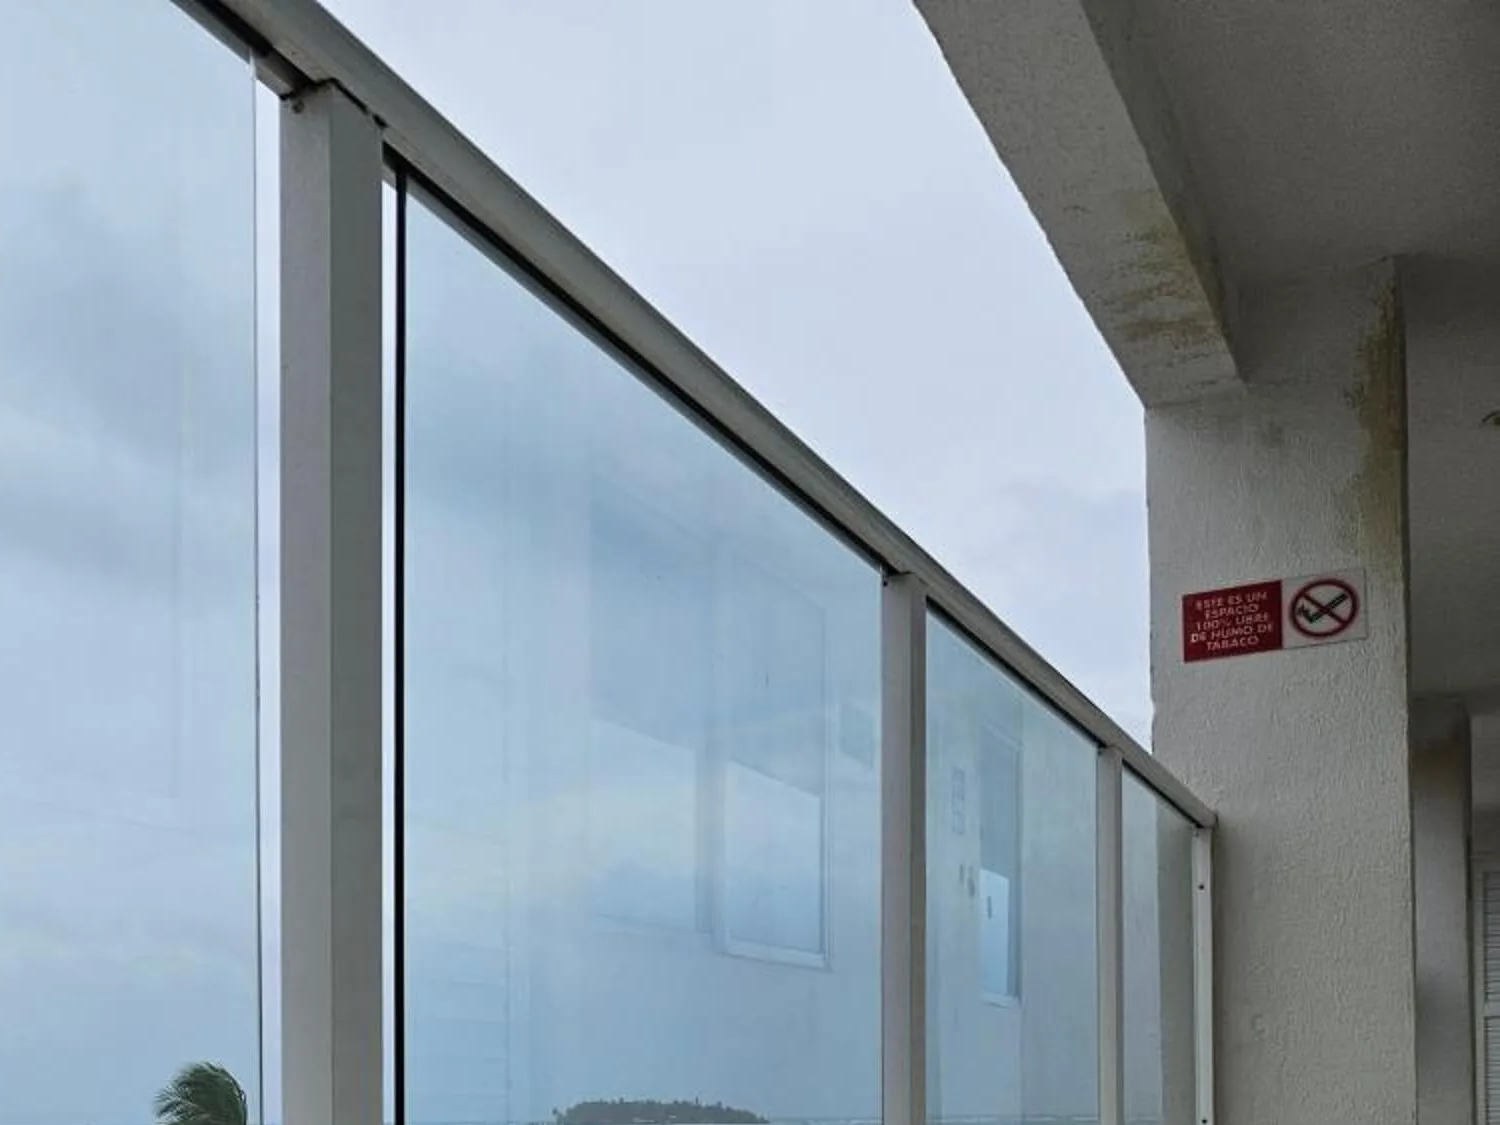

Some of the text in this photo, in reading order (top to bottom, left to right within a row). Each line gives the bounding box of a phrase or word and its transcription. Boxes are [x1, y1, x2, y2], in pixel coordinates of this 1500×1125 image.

[1228, 594, 1242, 604] ES
[1247, 592, 1268, 602] UN
[1205, 604, 1260, 619] ESPACIO
[1191, 623, 1273, 643] DE HUMO DE
[1207, 636, 1260, 651] TABACO
